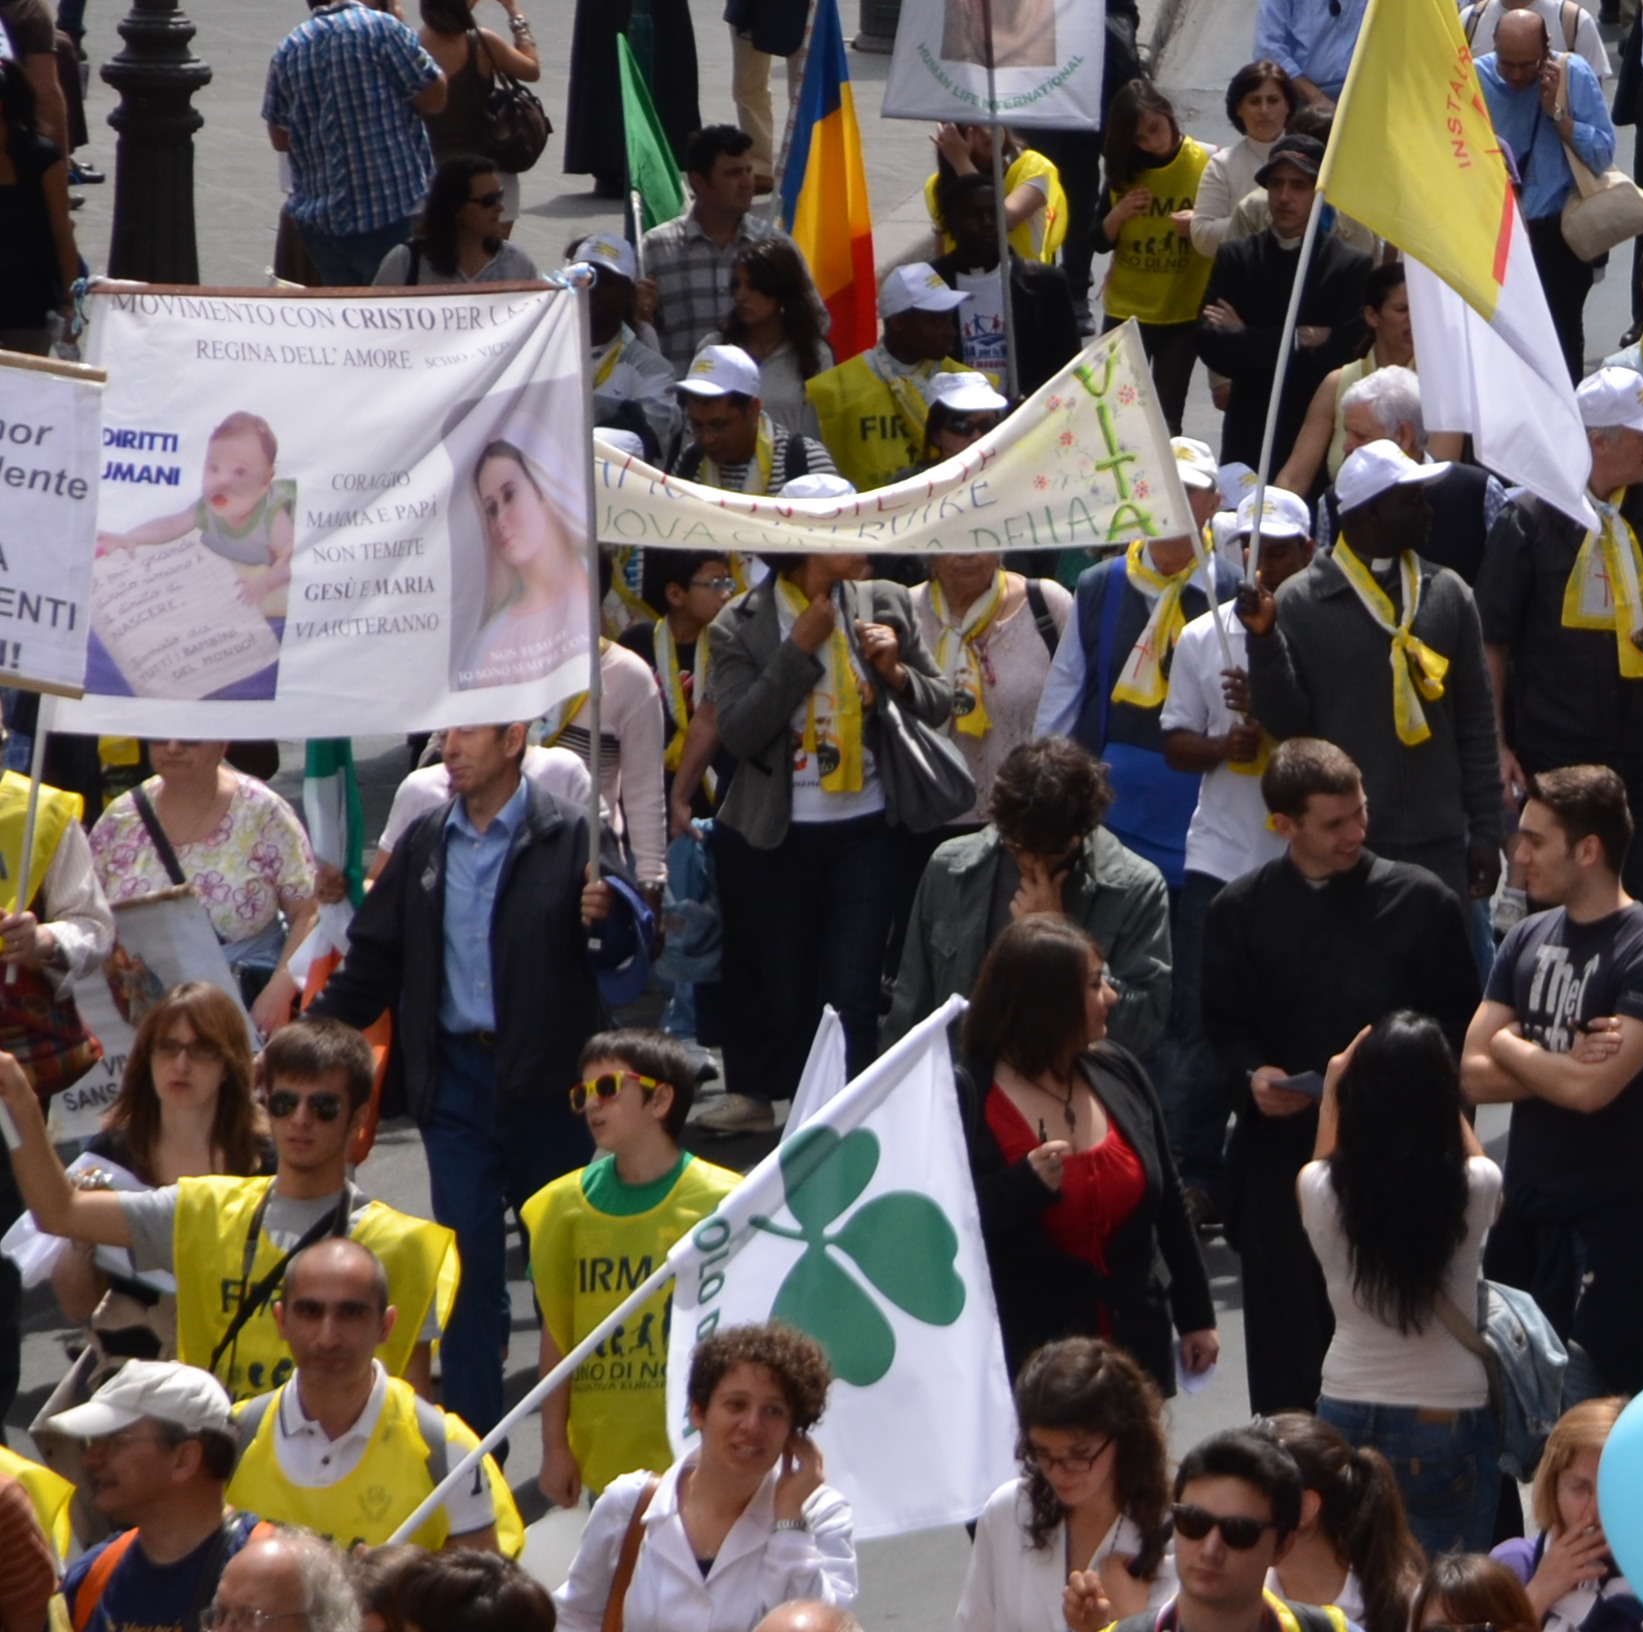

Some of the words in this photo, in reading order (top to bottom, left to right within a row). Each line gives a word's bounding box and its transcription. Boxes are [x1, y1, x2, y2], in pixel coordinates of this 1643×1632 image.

[917, 41, 952, 90] HUMAN
[952, 82, 981, 110] LIFE
[109, 293, 276, 327] MOVIMENTO
[280, 306, 336, 329] CON
[341, 307, 437, 331] CRISTO
[441, 305, 484, 331] PER
[195, 339, 279, 363] REGINA
[281, 344, 338, 366] DELL'
[343, 349, 414, 371] AMORE
[331, 469, 411, 492] CORAGGIO
[305, 505, 374, 529] MAMMA
[377, 508, 390, 522] E
[312, 543, 357, 563] NON
[359, 537, 425, 560] TEMETE
[303, 576, 356, 602] GESÙ
[360, 579, 371, 596] E
[371, 576, 435, 595] MARIA
[295, 617, 319, 638] VI
[320, 612, 440, 637] AIUTERANNO
[457, 669, 473, 683] IO
[475, 662, 509, 681] SONO
[609, 1361, 635, 1379] DI
